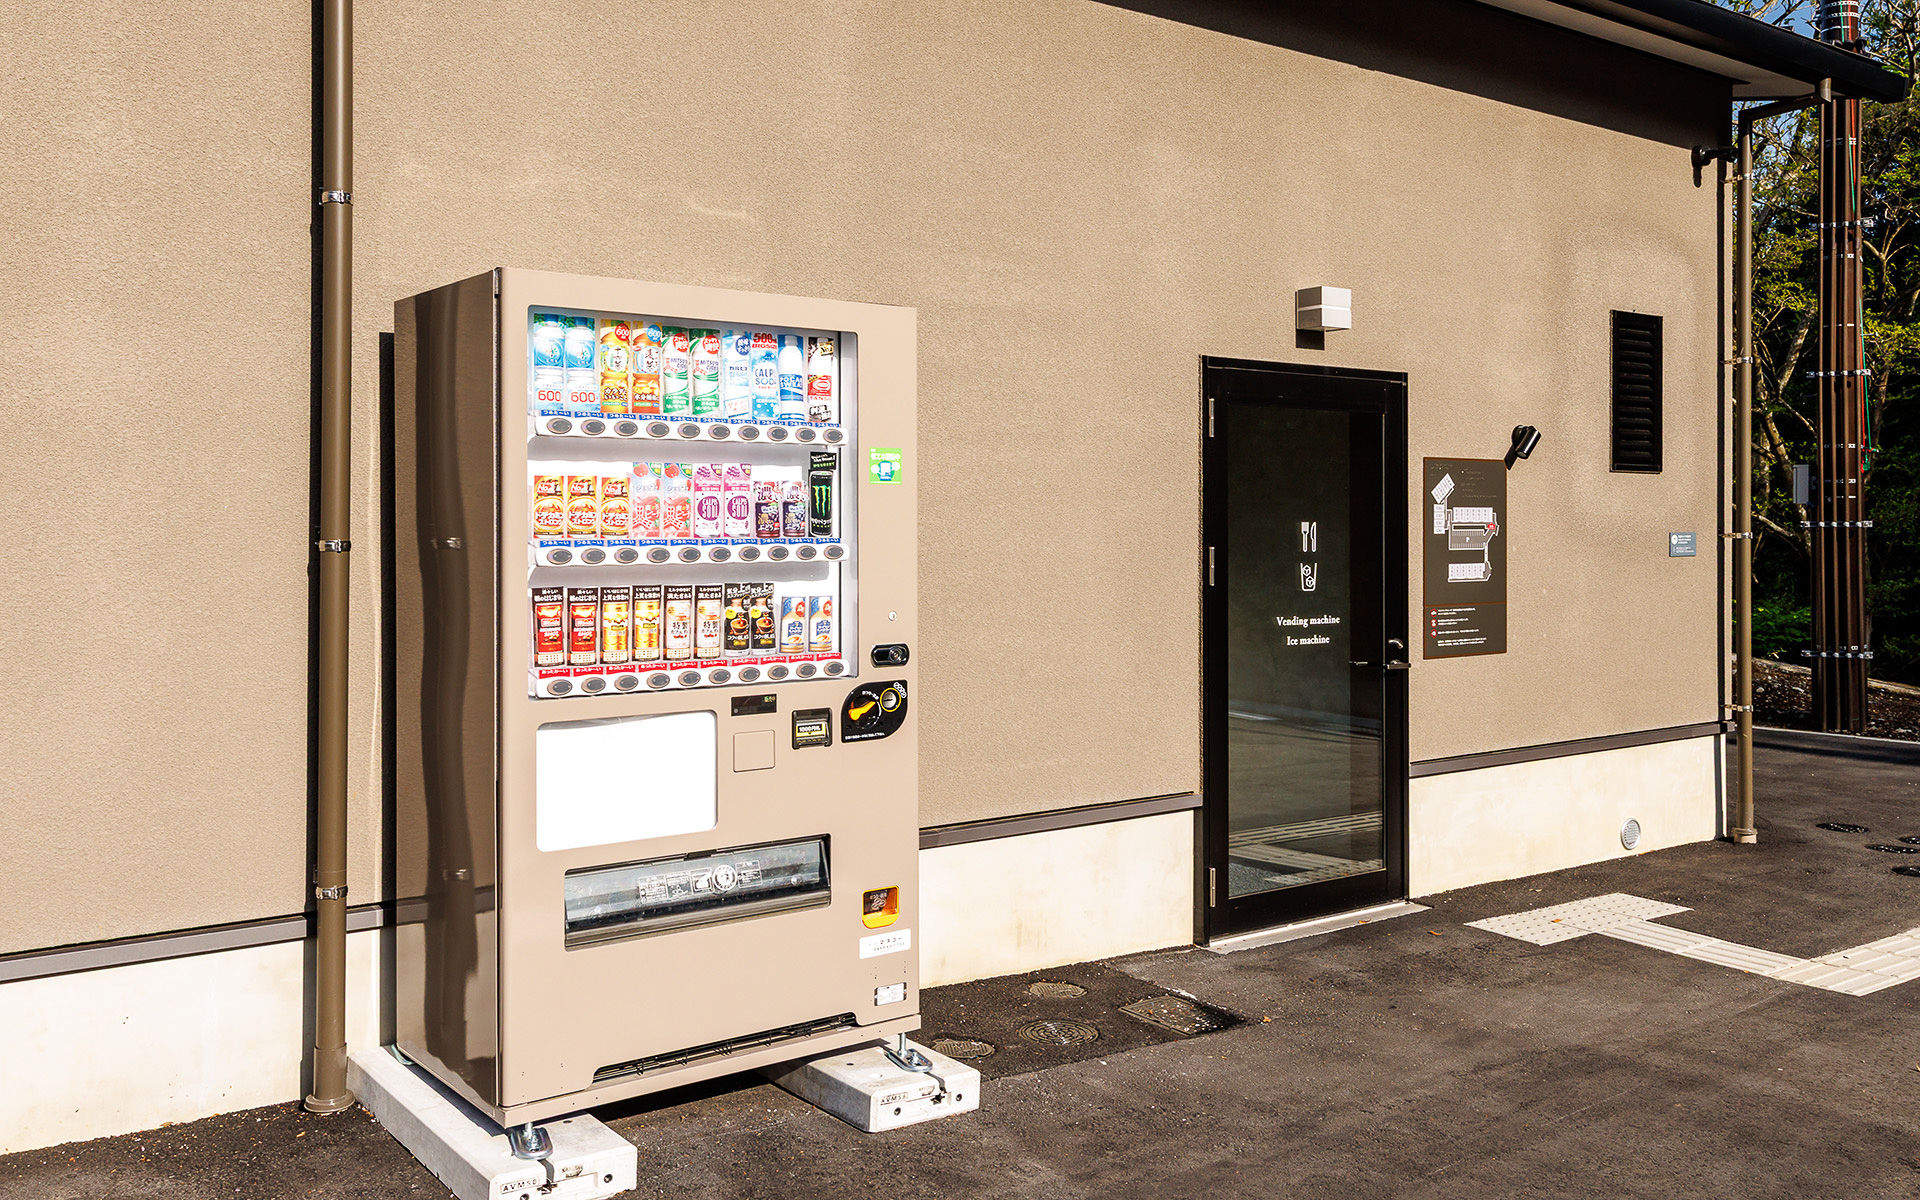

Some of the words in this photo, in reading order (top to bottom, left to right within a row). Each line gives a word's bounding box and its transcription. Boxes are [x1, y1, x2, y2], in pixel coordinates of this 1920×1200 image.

[538, 390, 561, 402] 600
[570, 391, 596, 403] 600
[1276, 615, 1309, 628] Vending
[1310, 615, 1340, 625] machine
[1286, 636, 1299, 645] Ice
[1300, 634, 1330, 645] machine
